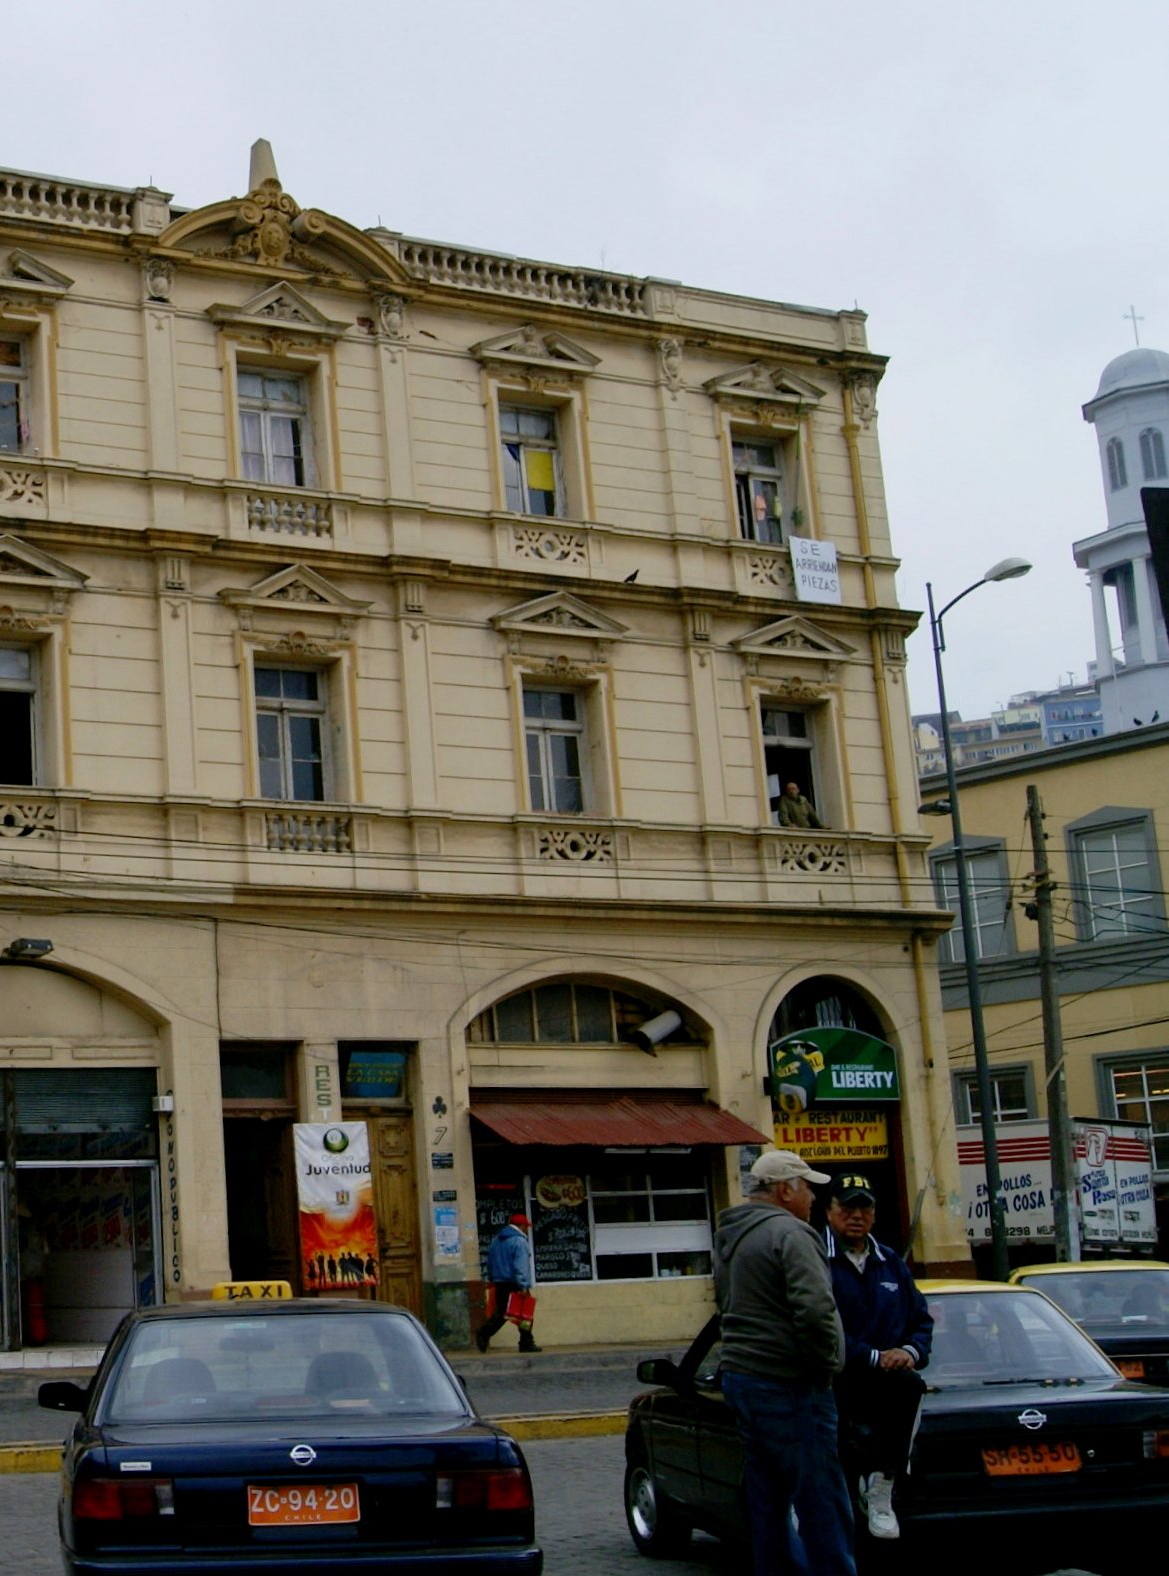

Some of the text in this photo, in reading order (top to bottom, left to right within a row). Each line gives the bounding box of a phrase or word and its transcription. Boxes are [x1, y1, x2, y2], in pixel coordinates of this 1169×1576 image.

[800, 541, 820, 556] SE
[801, 575, 837, 593] PIEZAS
[831, 1071, 894, 1088] LIBERTY
[809, 1111, 886, 1125] RESTAURANT
[433, 1127, 447, 1145] 7
[847, 1145, 871, 1156] PUERTO
[306, 1162, 372, 1176] Juventud
[842, 1176, 871, 1190] FBI
[1013, 1190, 1046, 1212] COSA
[224, 1284, 282, 1299] TAXI
